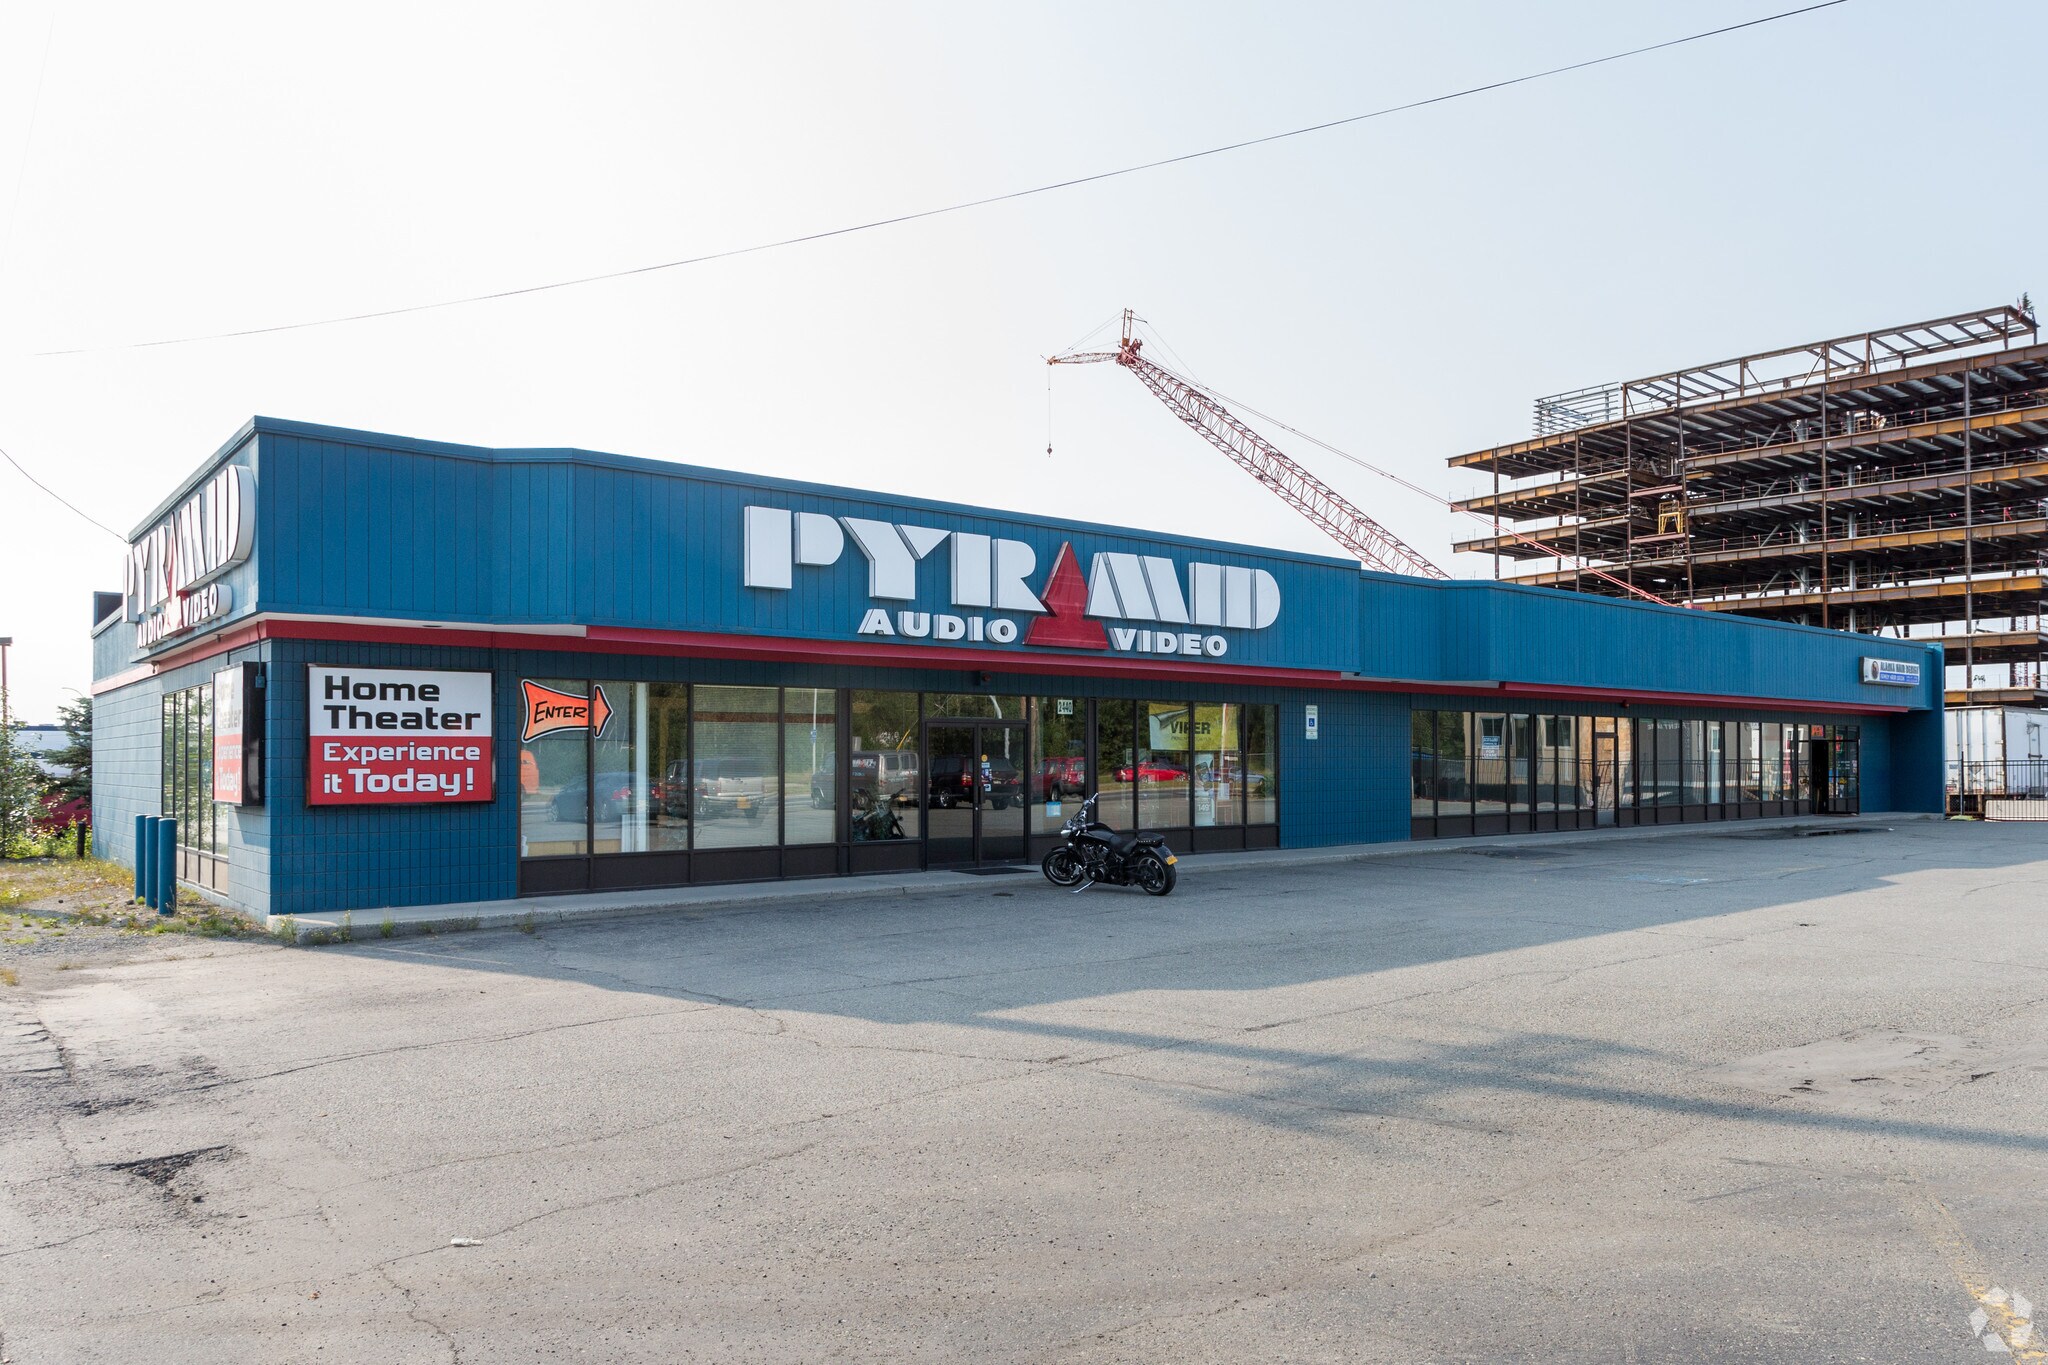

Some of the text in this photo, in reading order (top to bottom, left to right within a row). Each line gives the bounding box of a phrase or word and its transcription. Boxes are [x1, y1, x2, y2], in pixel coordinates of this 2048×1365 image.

[744, 505, 1281, 647] PYRAMID
[137, 583, 230, 648] AUDIO VIDEO
[857, 608, 1228, 657] AUDIO VIDEO
[324, 675, 440, 701] Home
[323, 705, 481, 730] Theater
[534, 700, 588, 723] ENTER
[323, 741, 480, 765] Experience
[323, 767, 474, 797] it Today!
